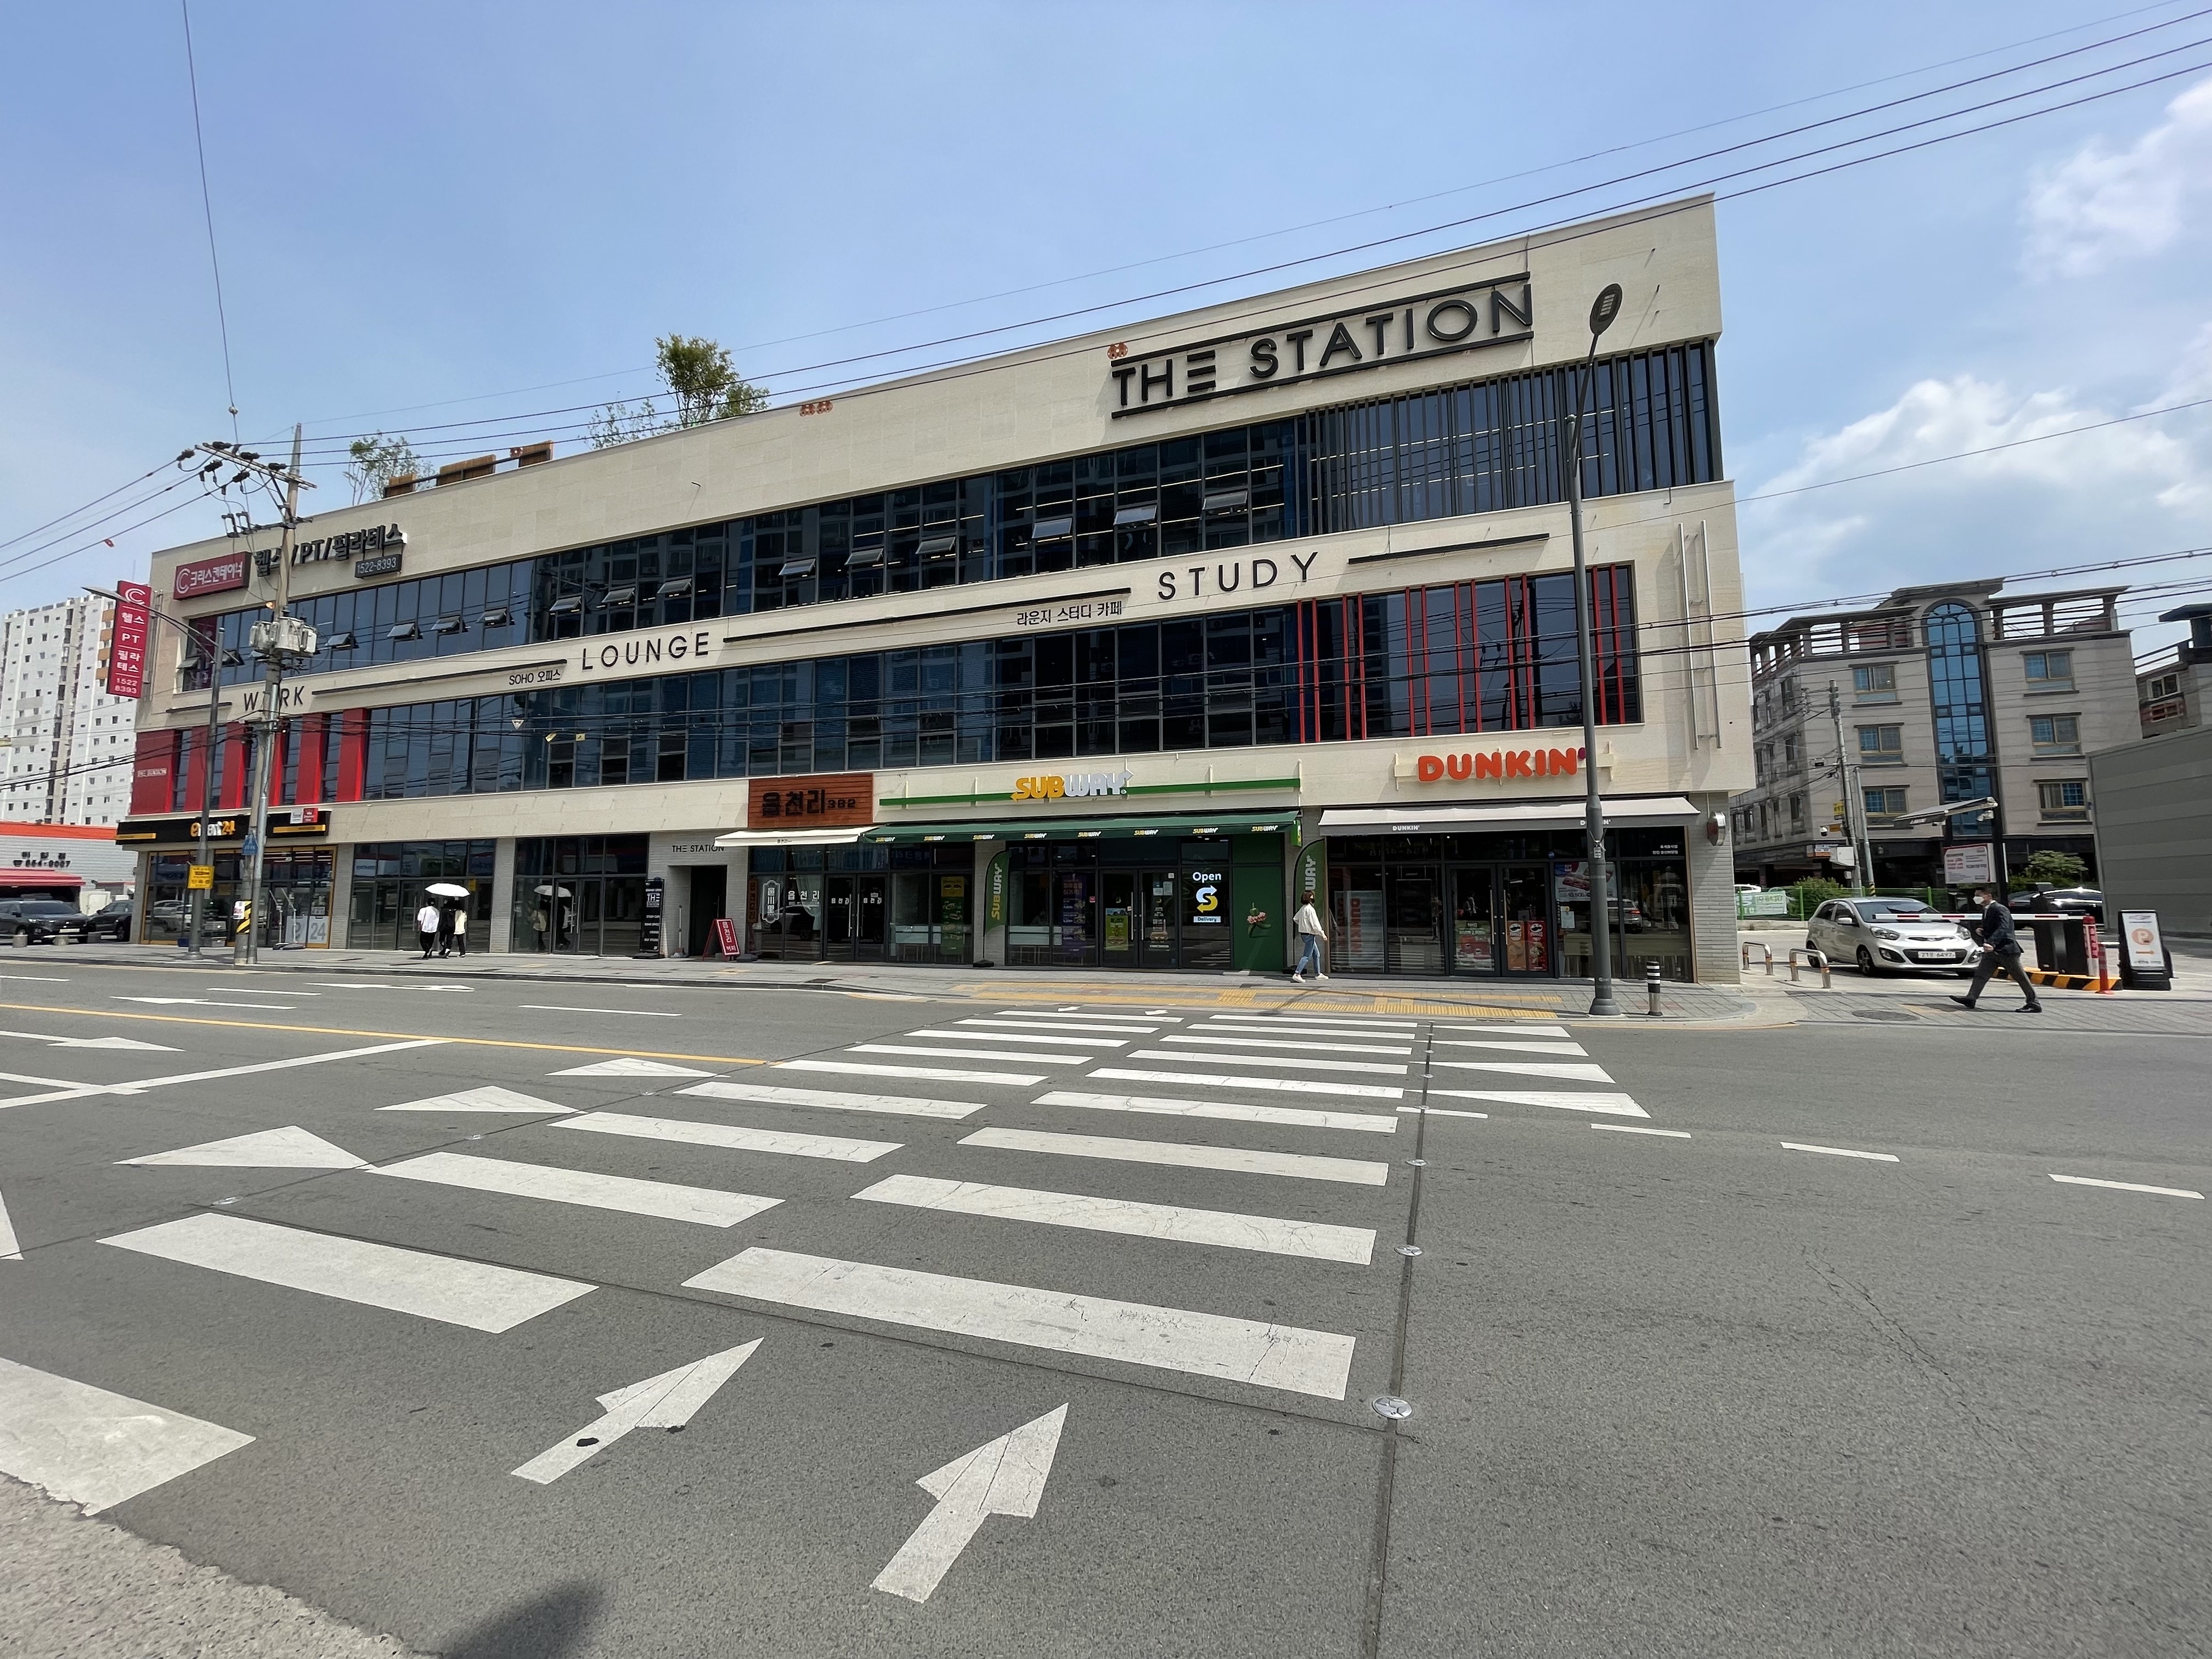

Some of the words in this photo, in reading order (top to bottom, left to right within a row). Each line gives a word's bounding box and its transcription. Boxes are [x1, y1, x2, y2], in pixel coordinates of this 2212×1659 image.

[1112, 349, 1216, 406] THE
[1250, 284, 1533, 379] STATION
[357, 556, 397, 574] 1522-8393
[1158, 552, 1318, 600] STUDY
[121, 612, 145, 624] 헬스
[1017, 609, 1051, 627] 라운지
[1057, 605, 1092, 623] 스터디
[1097, 600, 1122, 617] 카페
[122, 633, 140, 644] PT
[582, 632, 709, 670] LOUNGE
[116, 678, 138, 686] 1522
[509, 672, 534, 685] SOHO
[537, 669, 561, 682] 오피스
[114, 686, 137, 694] 8393
[244, 685, 304, 711] WRK
[1418, 747, 1586, 782] DUNKIN'
[1009, 768, 1134, 802] SUBWAY
[1193, 871, 1222, 883] Open
[647, 893, 660, 901] THE
[788, 890, 820, 900] 읍천리
[991, 862, 1002, 921] SUBWAY
[310, 922, 326, 940] 24
